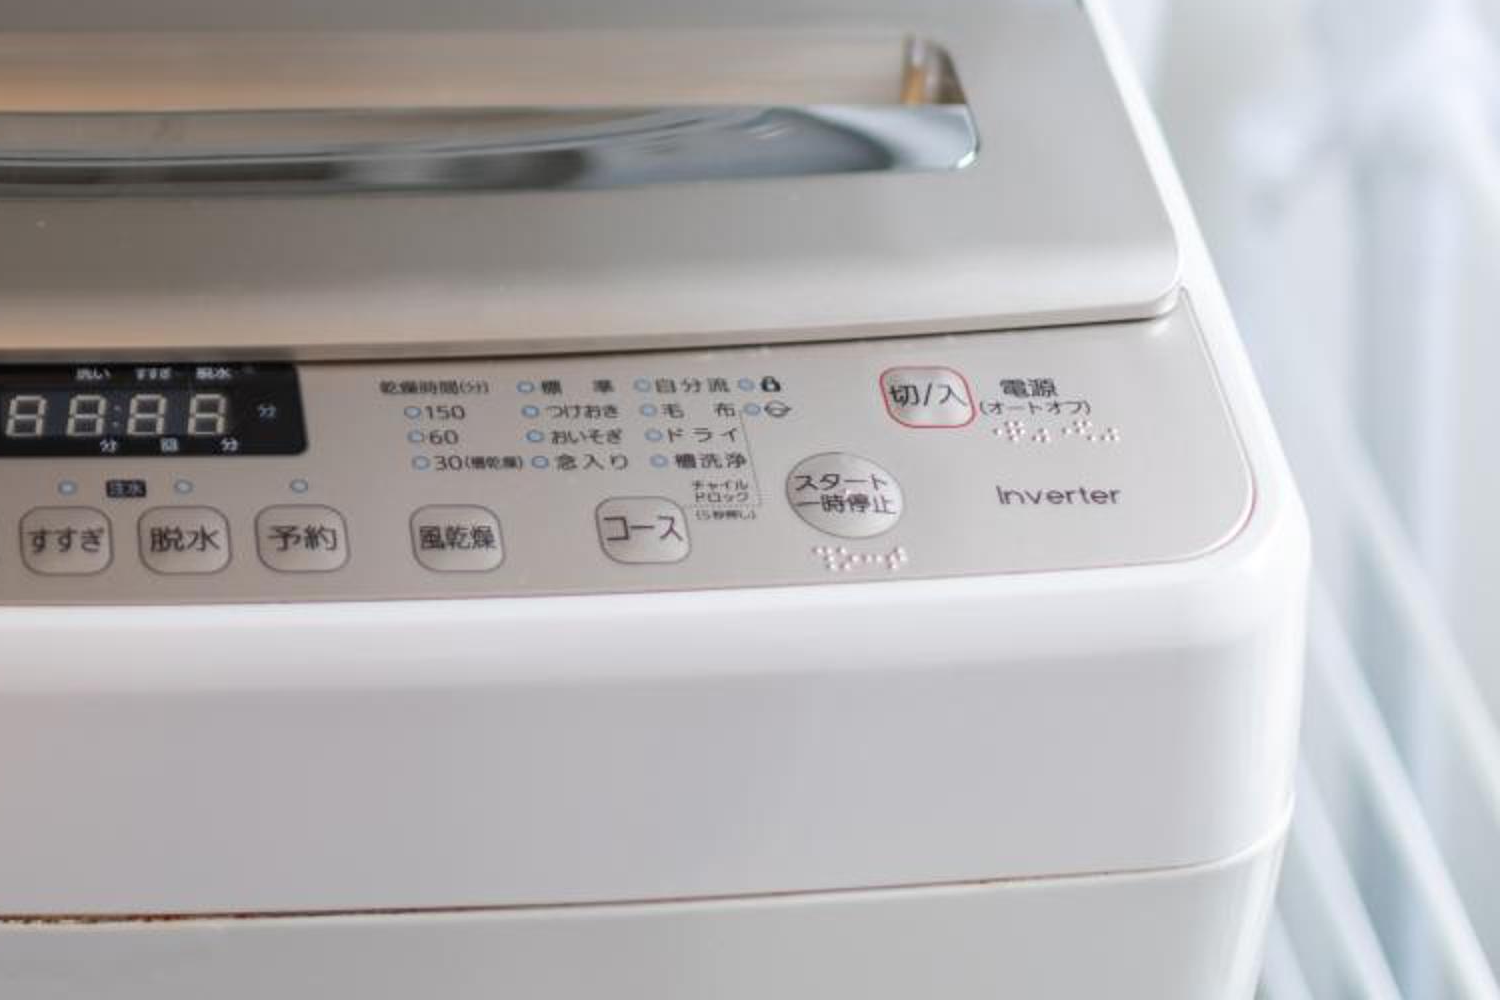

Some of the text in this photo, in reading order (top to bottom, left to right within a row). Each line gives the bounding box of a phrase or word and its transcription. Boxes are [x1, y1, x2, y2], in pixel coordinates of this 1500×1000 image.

[888, 384, 967, 407] 切/入
[999, 378, 1058, 398] 電源
[258, 404, 277, 419] 分
[425, 405, 466, 420] 150
[547, 404, 619, 419] つけおき
[429, 429, 458, 445] 60
[550, 428, 623, 445] おいそぎ
[557, 454, 628, 470] 念入り
[794, 473, 888, 491] スタート
[798, 494, 897, 515] 一時停止
[996, 485, 1122, 505] Inverter
[27, 526, 103, 550] すすぎ
[269, 524, 337, 551] 予約
[419, 525, 496, 550] 風乾燥
[603, 515, 683, 541] コース
[150, 527, 220, 551] 脱水
